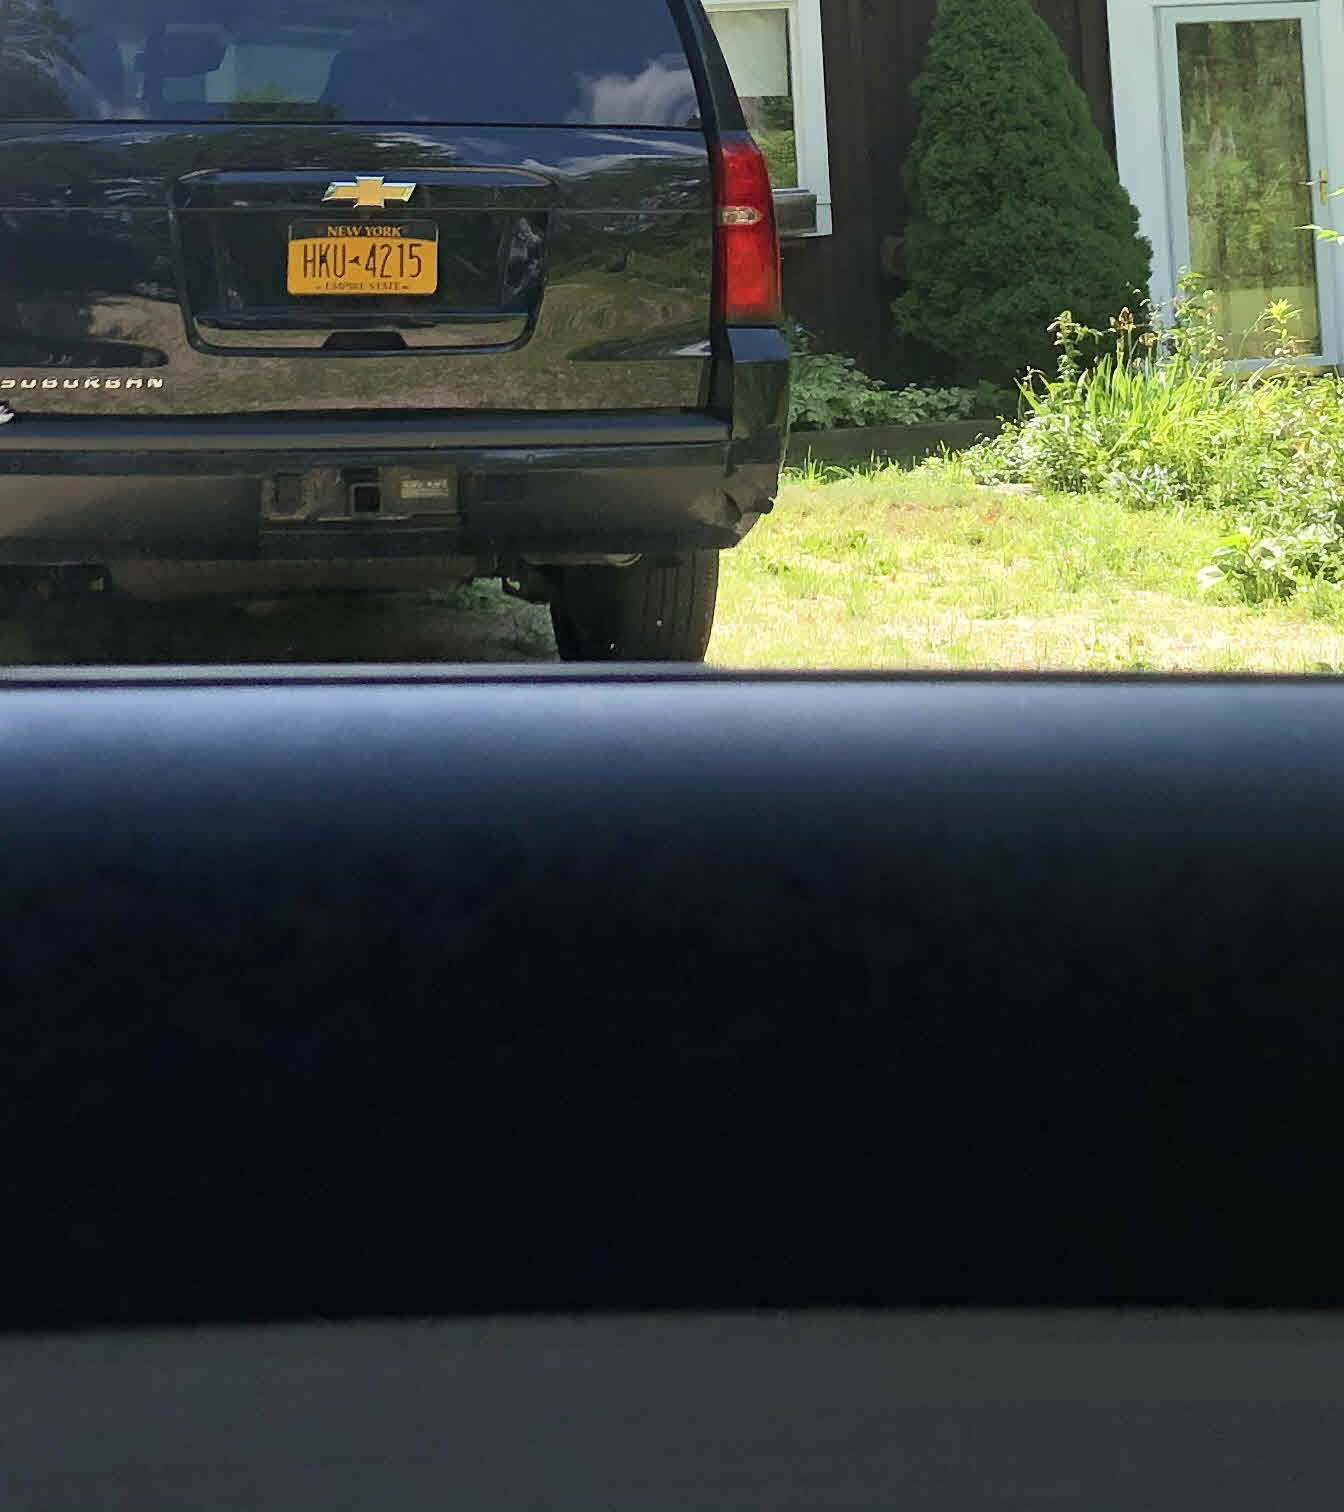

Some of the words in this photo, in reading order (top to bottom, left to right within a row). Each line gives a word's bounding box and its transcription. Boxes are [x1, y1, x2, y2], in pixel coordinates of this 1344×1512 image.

[327, 225, 360, 237] NEW
[365, 225, 402, 237] YORK
[0, 376, 165, 390] SUBURBAN
